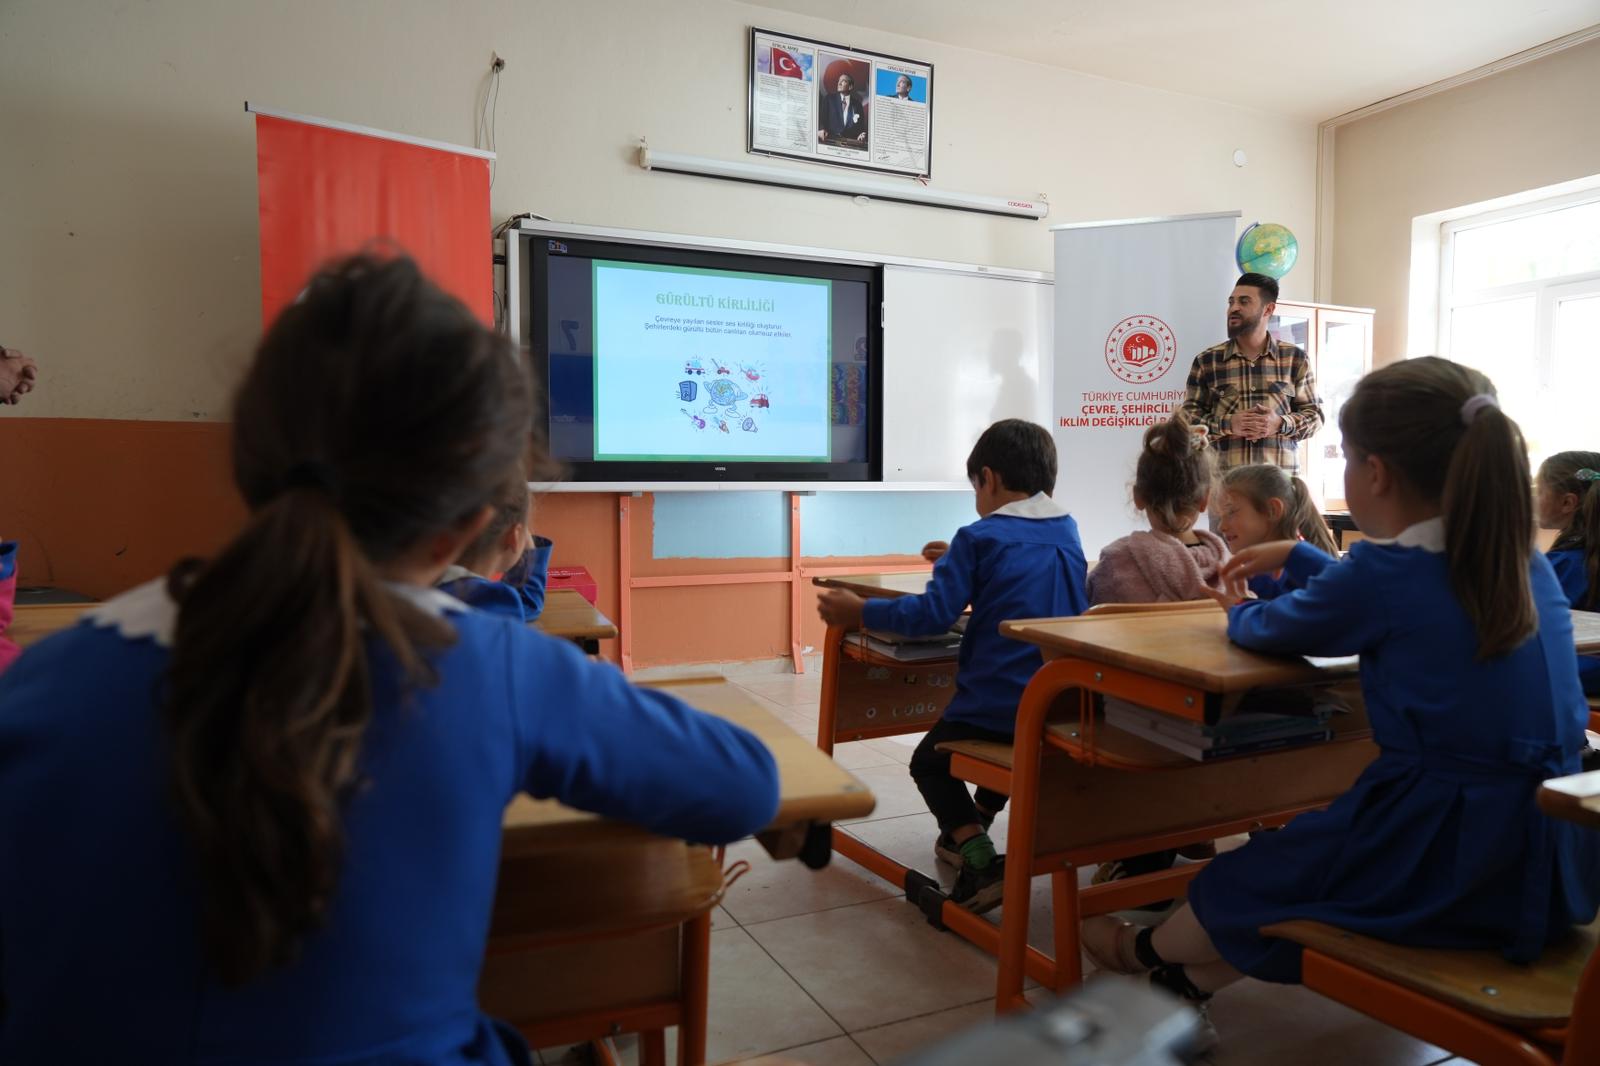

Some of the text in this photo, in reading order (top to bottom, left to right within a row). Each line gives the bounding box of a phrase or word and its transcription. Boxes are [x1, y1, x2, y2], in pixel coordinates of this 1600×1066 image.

[656, 291, 775, 313] GÜRÜLTÜ KİRLİLİĞİ
[1082, 390, 1123, 402] TÜRKİYE
[1082, 402, 1179, 416] ÇEVRE, ŞEHİRCİLİ
[1060, 416, 1090, 427] İKLİM
[1092, 414, 1157, 429] DEĞİŞİKLİĞİ
